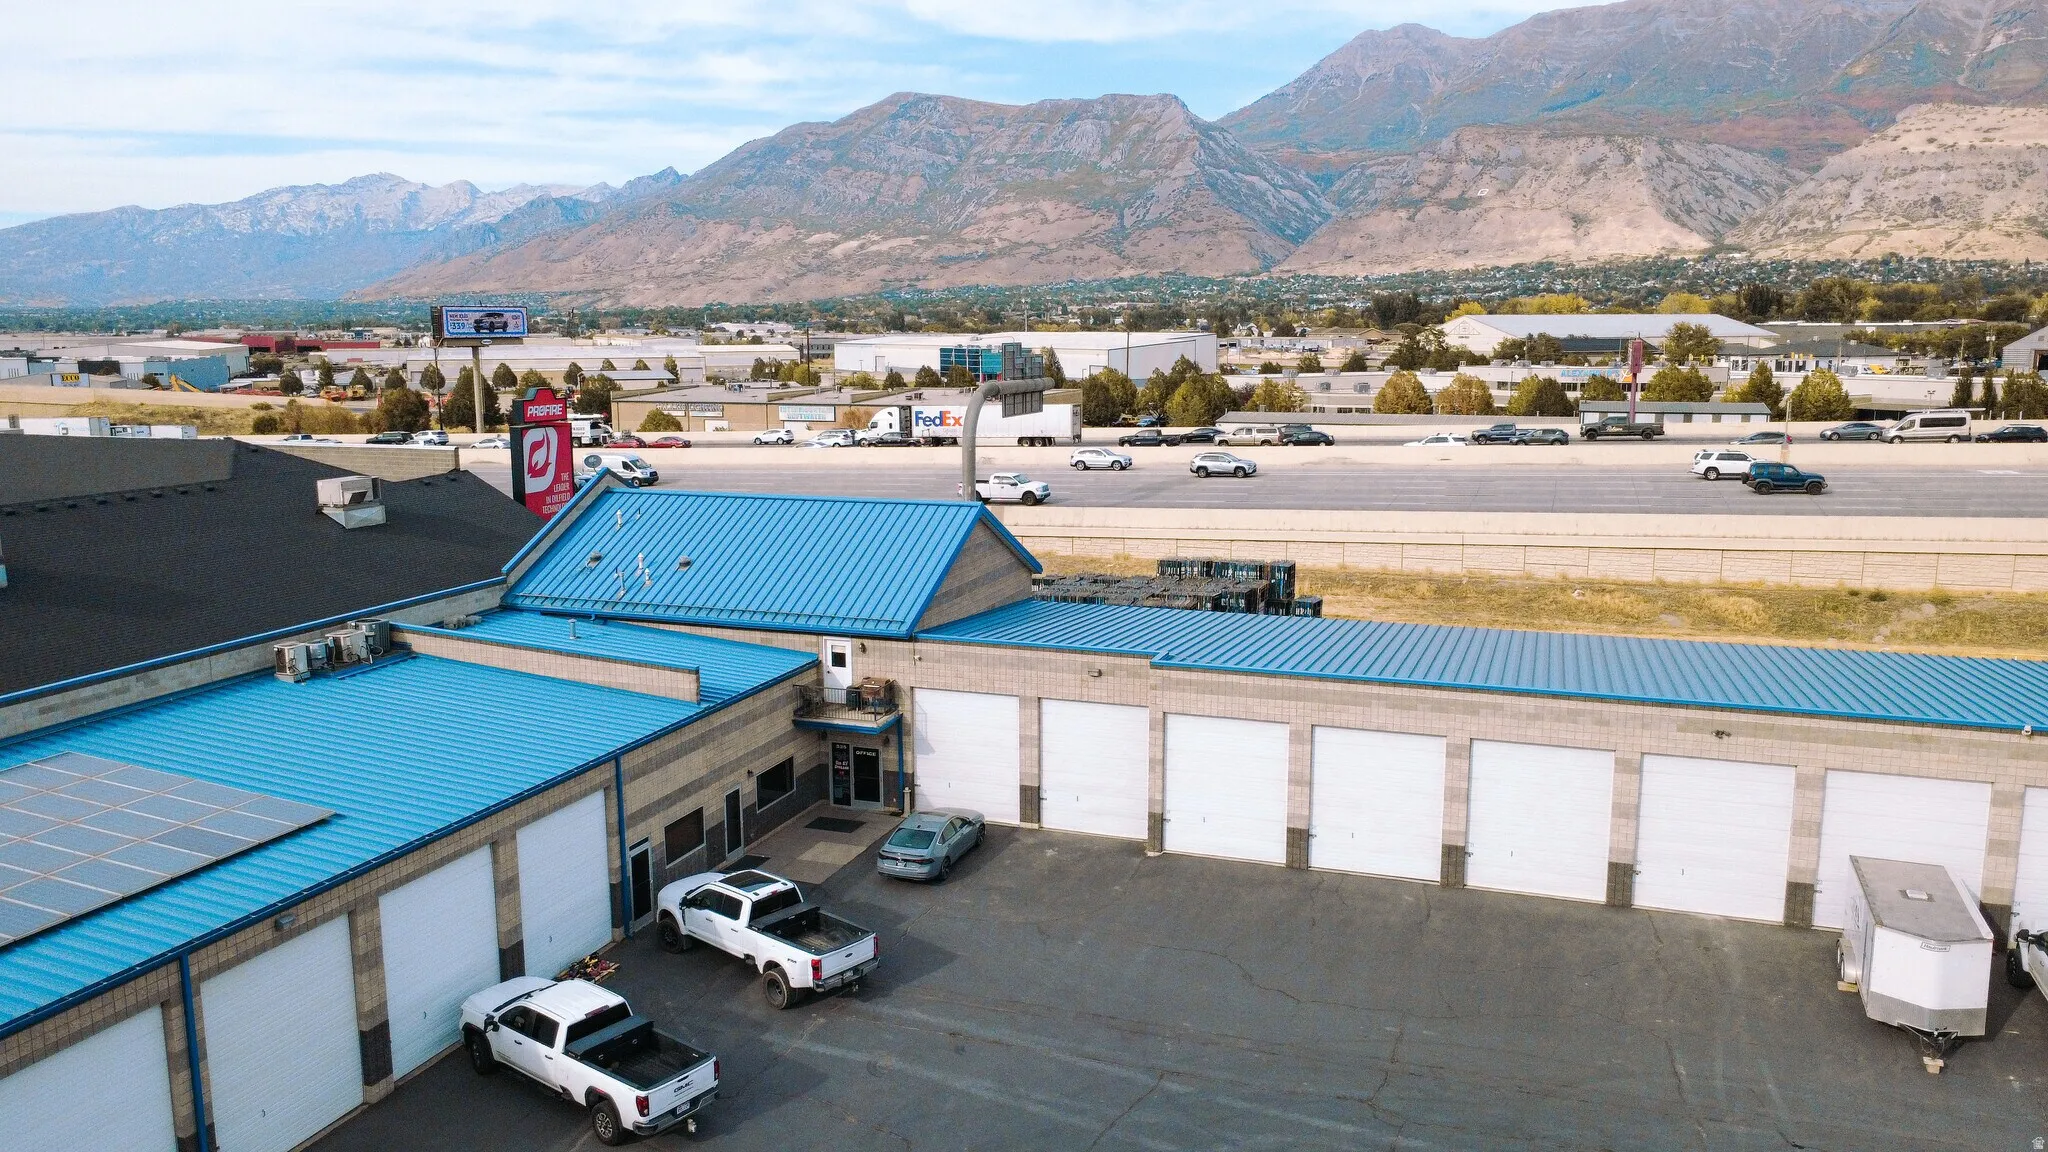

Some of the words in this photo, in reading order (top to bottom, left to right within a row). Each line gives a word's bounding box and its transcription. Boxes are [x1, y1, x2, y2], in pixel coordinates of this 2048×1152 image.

[527, 404, 563, 418] PROFIRE
[915, 411, 963, 427] FedEx
[561, 472, 570, 481] THE
[553, 482, 570, 493] LEADER
[545, 496, 552, 504] IN
[552, 492, 571, 503] OILFIELD
[542, 502, 568, 514] TECHNOLO
[674, 1080, 694, 1093] GMC
